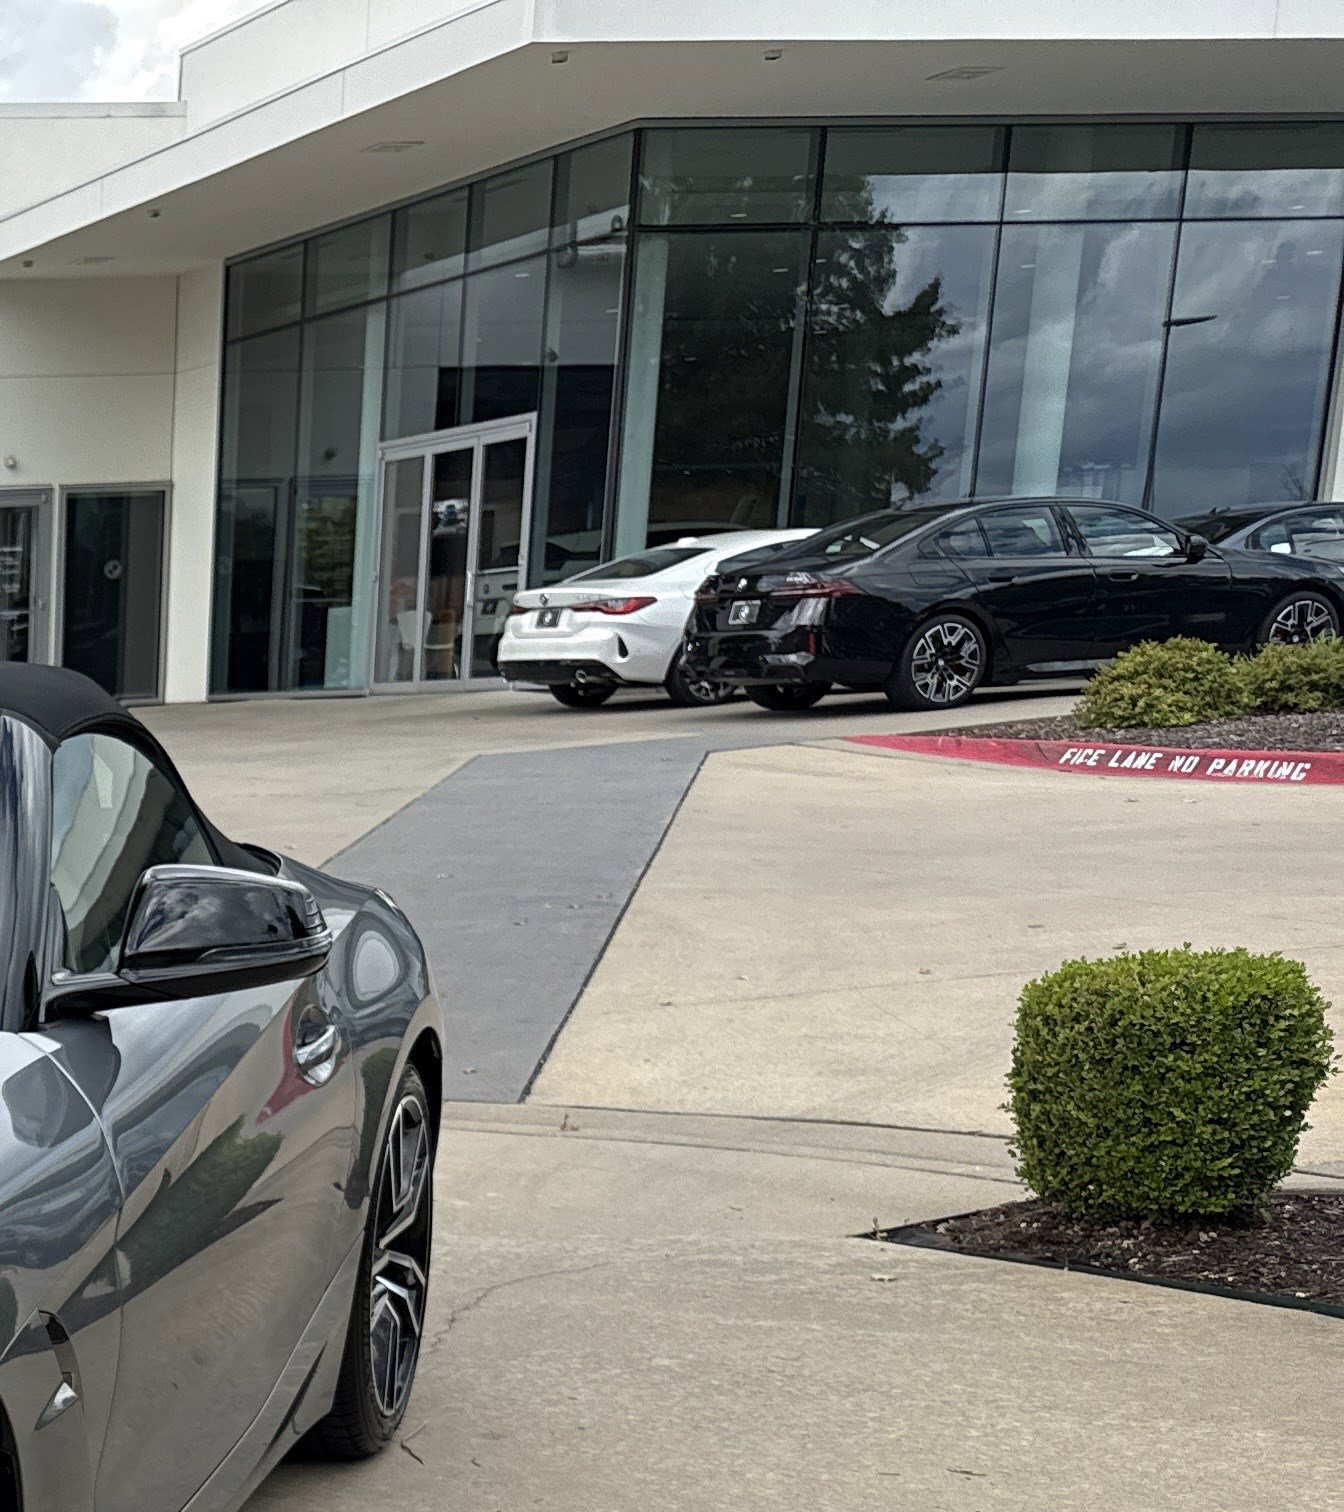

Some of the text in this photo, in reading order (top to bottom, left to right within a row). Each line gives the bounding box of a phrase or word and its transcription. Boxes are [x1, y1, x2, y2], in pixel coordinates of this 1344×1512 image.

[1108, 750, 1163, 770] LANE
[1168, 756, 1201, 773] NO
[1206, 759, 1312, 781] PARKING
